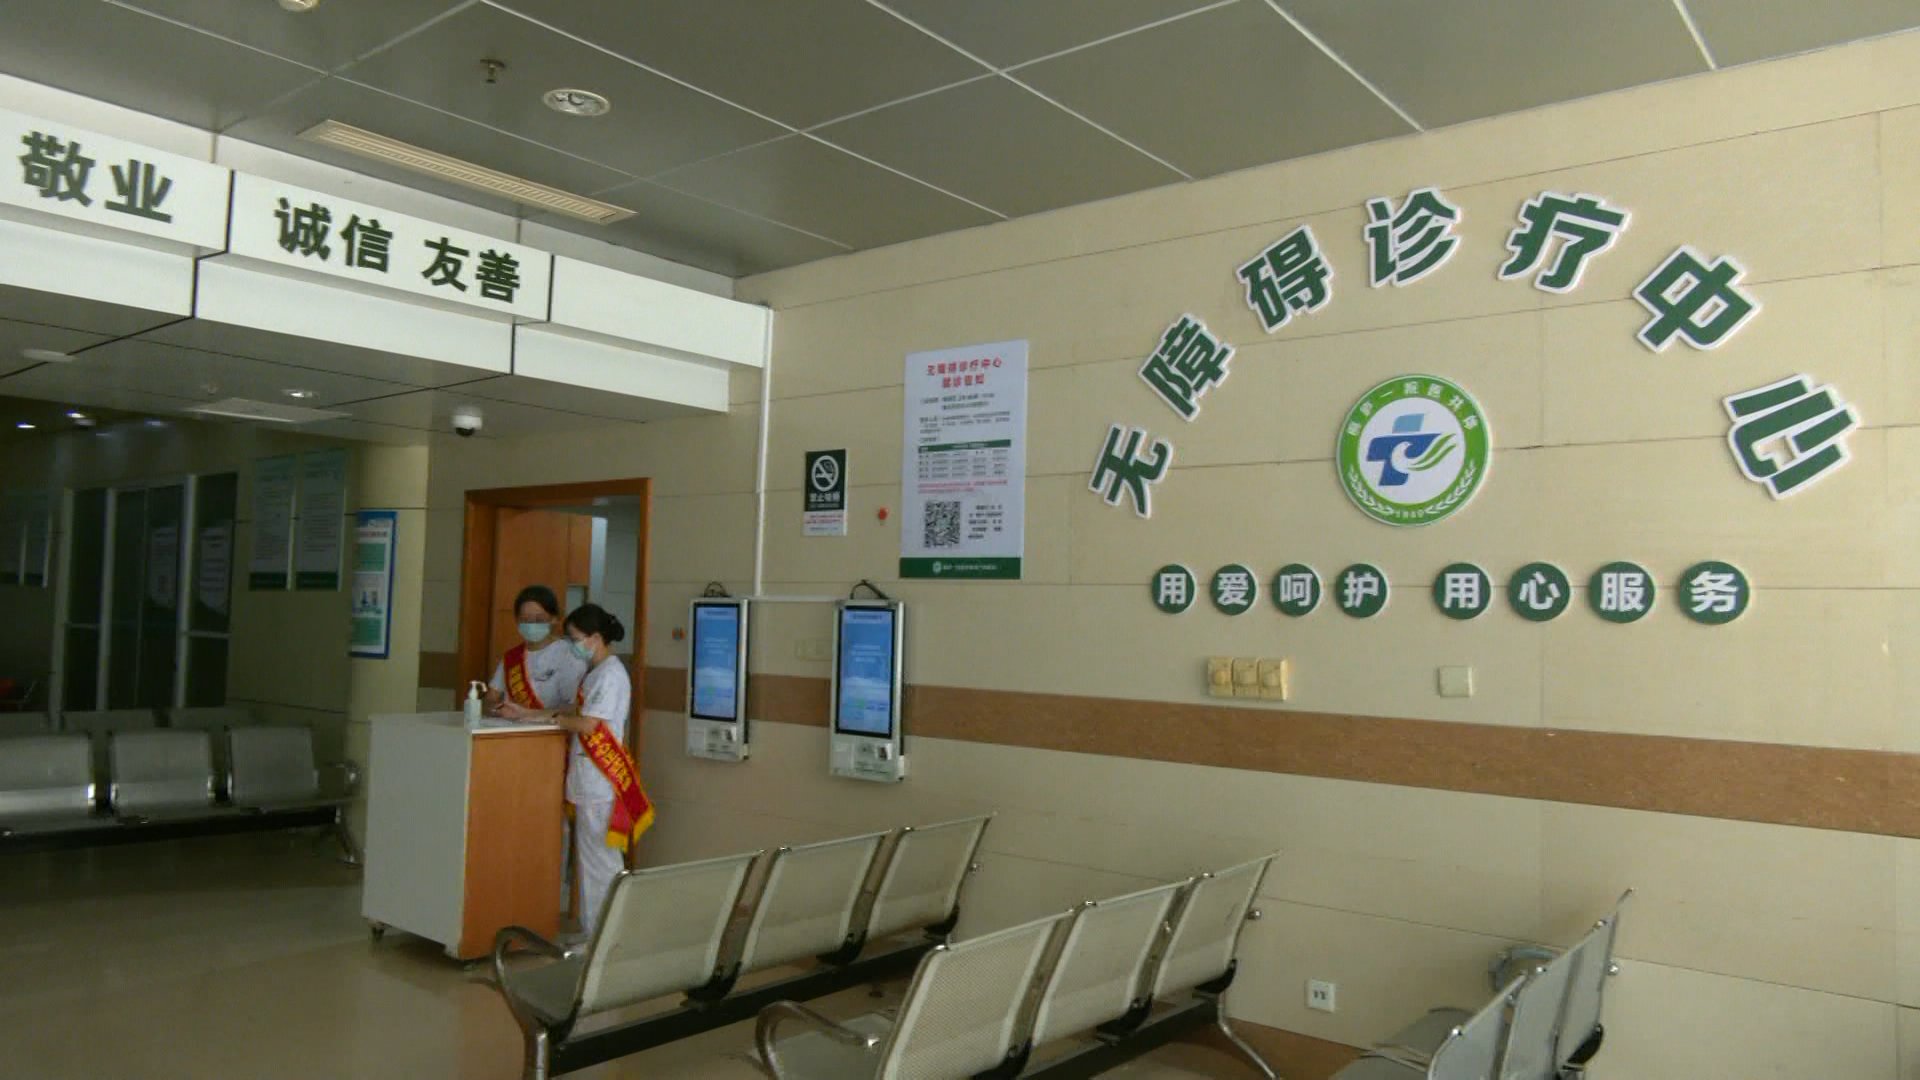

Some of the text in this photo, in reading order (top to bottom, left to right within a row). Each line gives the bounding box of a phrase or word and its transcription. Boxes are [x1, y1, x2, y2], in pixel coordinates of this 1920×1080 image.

[18, 131, 172, 223] 敬业
[274, 196, 521, 304] 诚信 友善
[1089, 188, 1859, 517] 无障碍诊疗中心
[1159, 572, 1738, 613] 用爱呵护 用心服务
